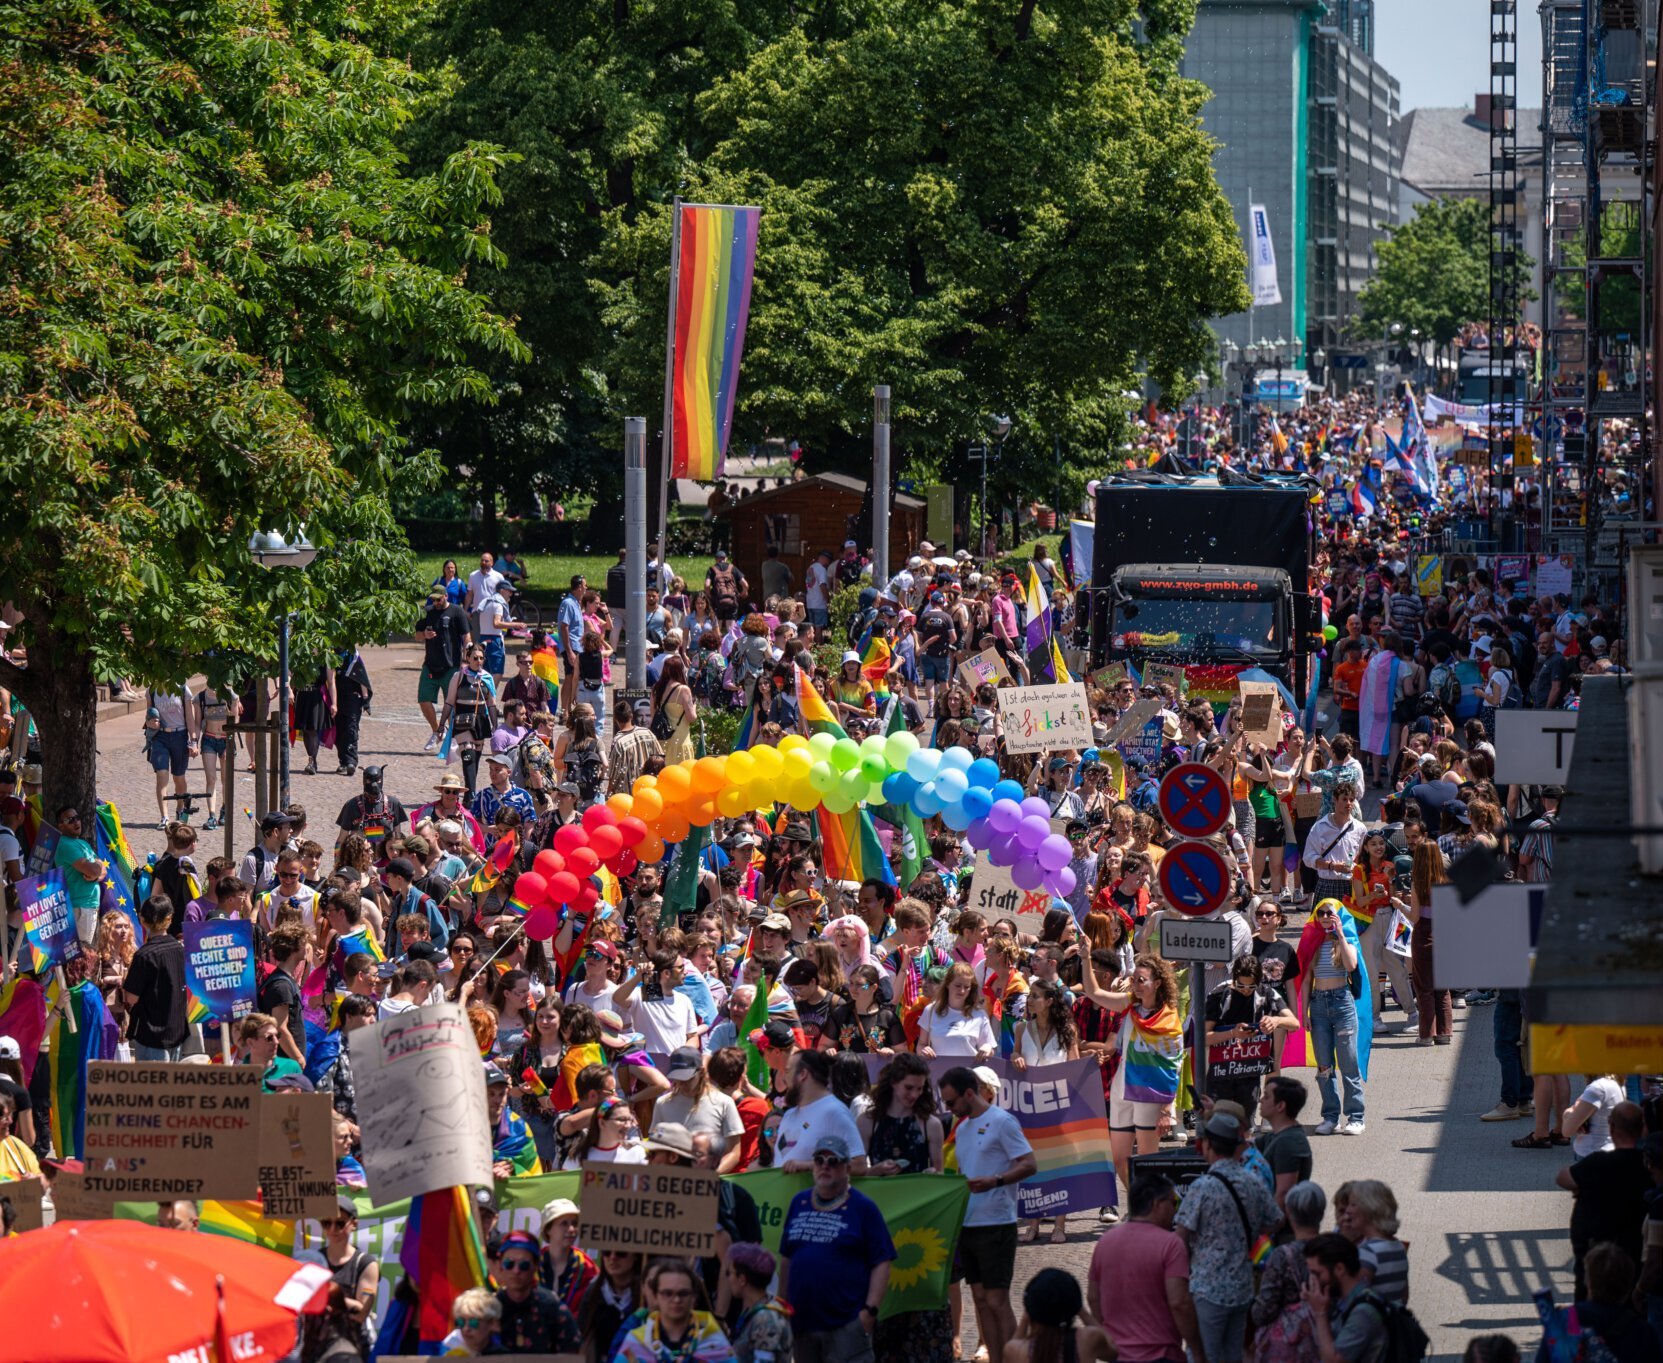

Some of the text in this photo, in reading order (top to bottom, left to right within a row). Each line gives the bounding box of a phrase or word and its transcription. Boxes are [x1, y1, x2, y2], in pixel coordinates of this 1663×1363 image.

[1140, 580, 1258, 591] www.zwo-gmbh.de
[1020, 690, 1040, 703] doch
[26, 890, 66, 918] MY LOVE IS
[978, 885, 1019, 912] statt
[32, 903, 68, 929] BLIND FOR
[39, 917, 69, 940] GENDER!
[199, 933, 235, 949] QUEERE
[1165, 931, 1226, 950] Ladezone
[190, 945, 248, 966] RECHTE SIND
[194, 964, 248, 980] MENSCHEN-
[205, 975, 242, 992] RECHTE!
[1232, 1044, 1262, 1059] FUCK
[89, 1068, 168, 1085] @HOLGER
[1213, 1061, 1267, 1077] the Patriarchy
[87, 1093, 250, 1110] WARUM GIBT ES AM
[998, 1078, 1070, 1114] DICE!
[87, 1113, 249, 1130] KIT KEINE CHANCEN-
[86, 1131, 214, 1149] GLEICHHEIT FÜR
[259, 1165, 312, 1182] SELBST-
[84, 1177, 204, 1193] STUDIERENDE?
[261, 1181, 337, 1198] BESTIMMUNG
[584, 1170, 719, 1197] PFADIS GEGEN
[1018, 1187, 1042, 1200] ÜNE
[1025, 1190, 1068, 1209] JUGEND
[263, 1199, 305, 1215] JETZT!
[614, 1198, 684, 1219] QUEER-
[580, 1223, 715, 1249] FEINDLICHKEIT
